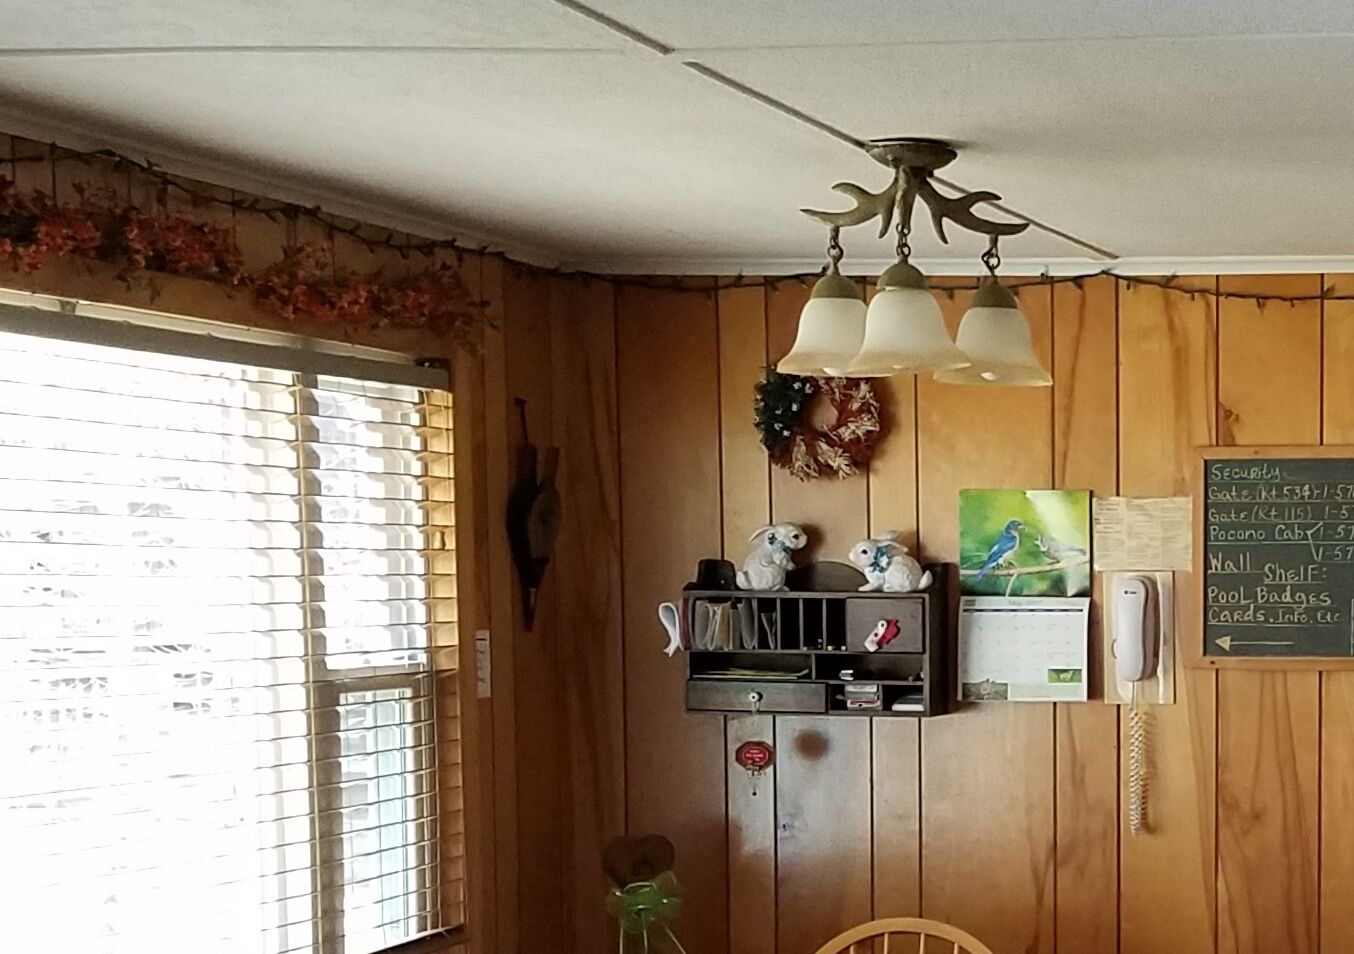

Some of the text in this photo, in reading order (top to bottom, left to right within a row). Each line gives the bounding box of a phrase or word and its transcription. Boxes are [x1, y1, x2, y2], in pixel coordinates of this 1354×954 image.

[1208, 486, 1252, 500] Gate
[1208, 508, 1248, 523] Gate
[1209, 525, 1266, 541] Pocono
[1275, 523, 1304, 540] Cab
[1209, 552, 1250, 573] Wall
[1256, 584, 1332, 610] Badges
